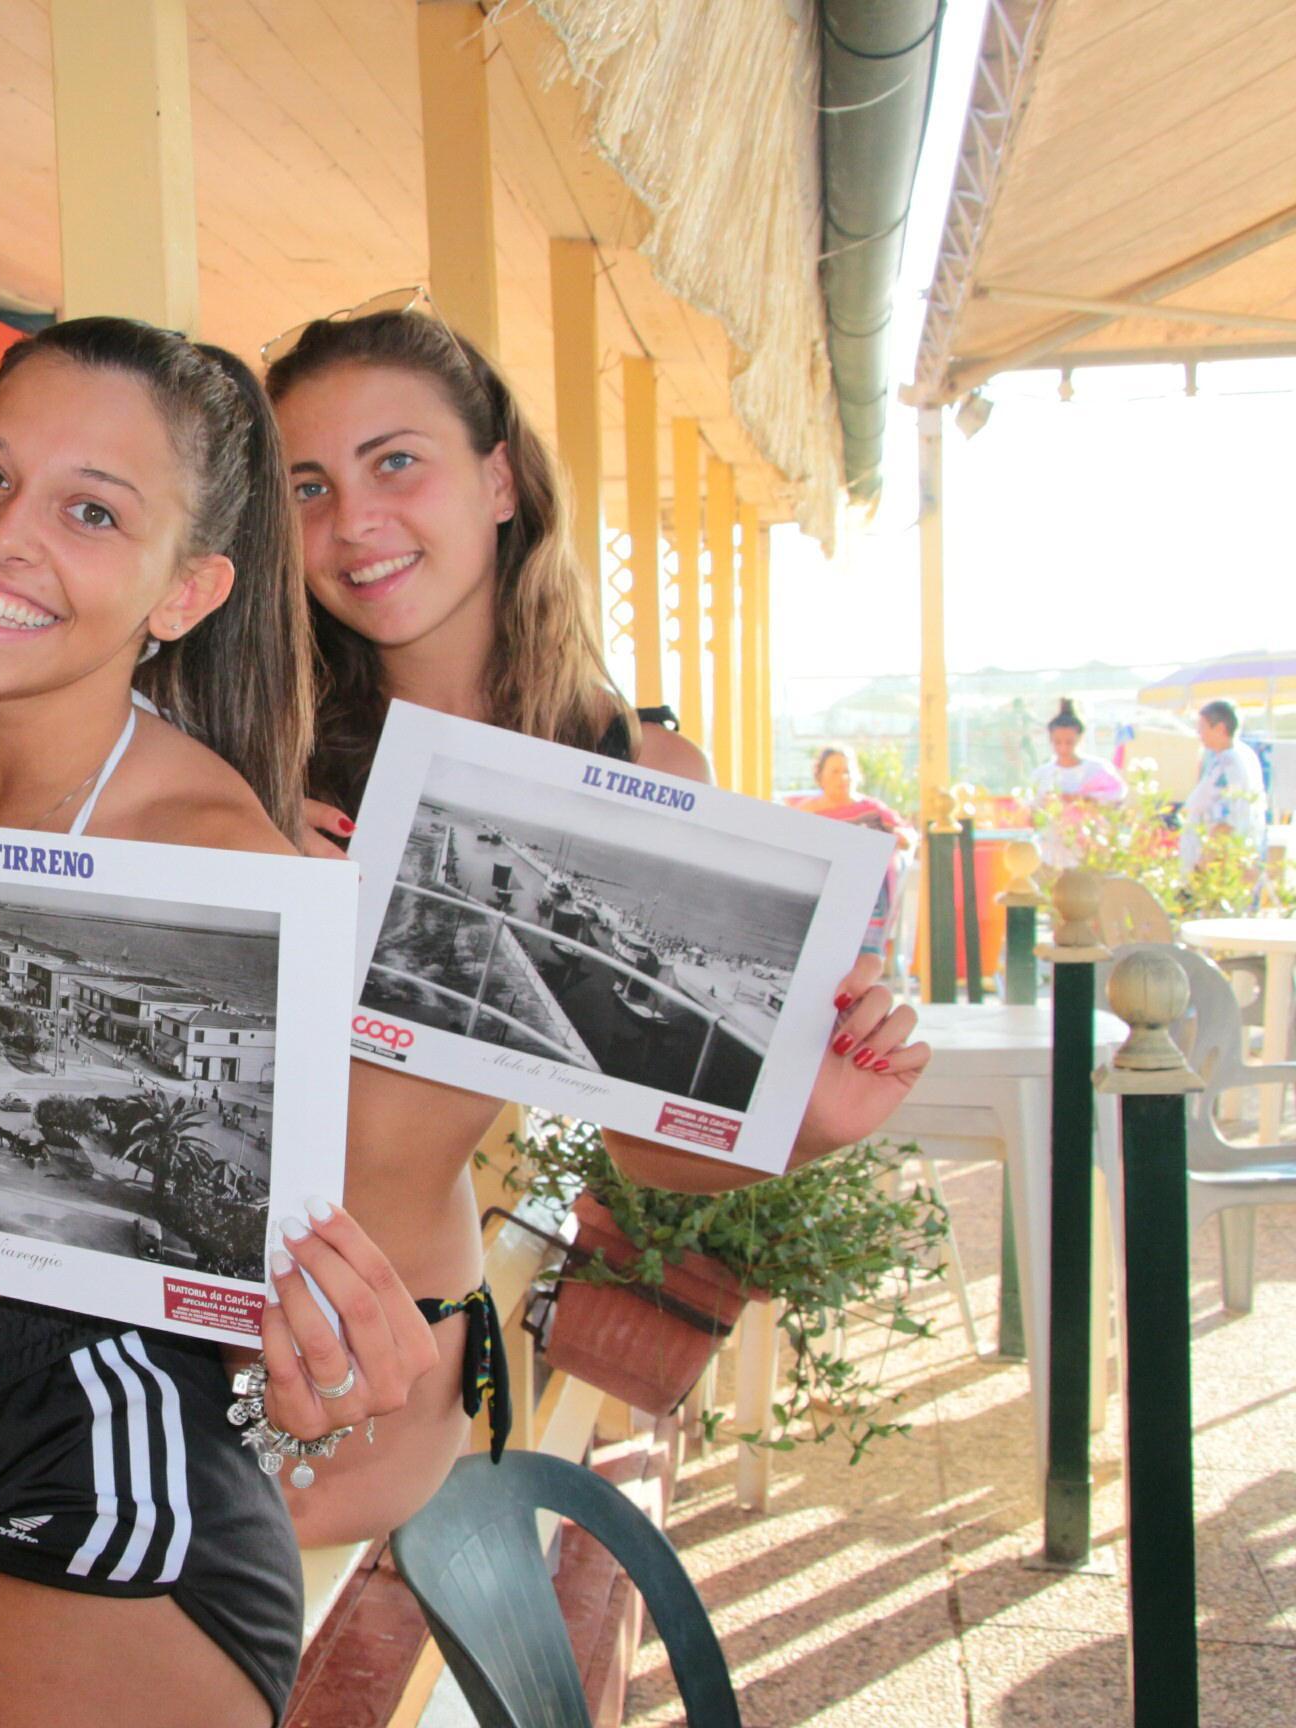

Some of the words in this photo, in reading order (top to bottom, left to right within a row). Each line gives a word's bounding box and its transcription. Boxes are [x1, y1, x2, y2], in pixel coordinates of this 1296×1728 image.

[582, 765, 602, 787] IL
[606, 771, 695, 812] TIRRENO
[351, 1015, 415, 1050] coop
[549, 1065, 612, 1096] Viareggio
[167, 1283, 208, 1299] TRATTORIA
[209, 1289, 222, 1301] da
[227, 1307, 248, 1316] MARE
